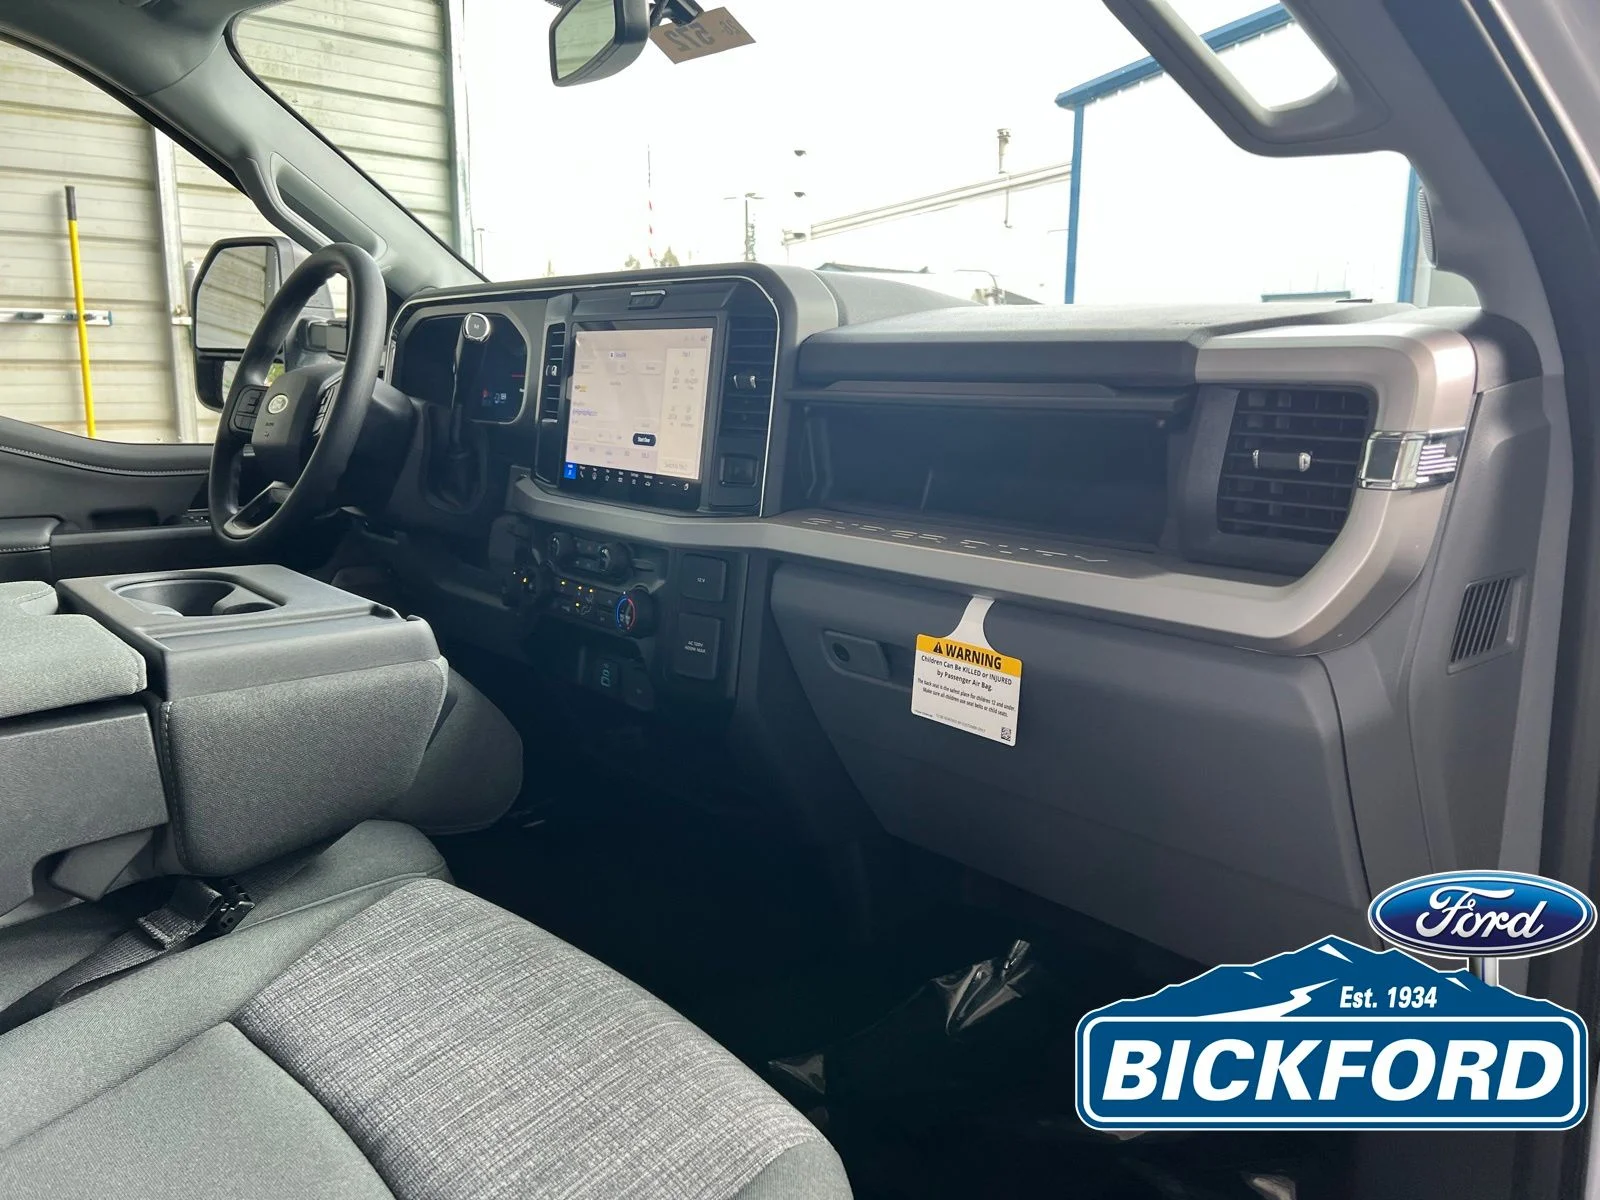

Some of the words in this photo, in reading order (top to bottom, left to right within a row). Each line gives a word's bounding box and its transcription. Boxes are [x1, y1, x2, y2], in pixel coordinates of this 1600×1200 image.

[801, 516, 946, 544] SUPER
[959, 538, 1109, 563] DUTY
[945, 644, 1002, 670] WARNING
[921, 655, 942, 666] Children
[943, 661, 954, 669] Can
[955, 664, 962, 672] Be
[962, 666, 981, 677] KILLED
[989, 673, 1012, 686] INJURED
[937, 669, 944, 678] by
[944, 671, 971, 686] Passenger
[972, 679, 980, 687] Air
[981, 682, 993, 692] Bag.
[945, 694, 959, 702] children
[976, 695, 991, 704] children
